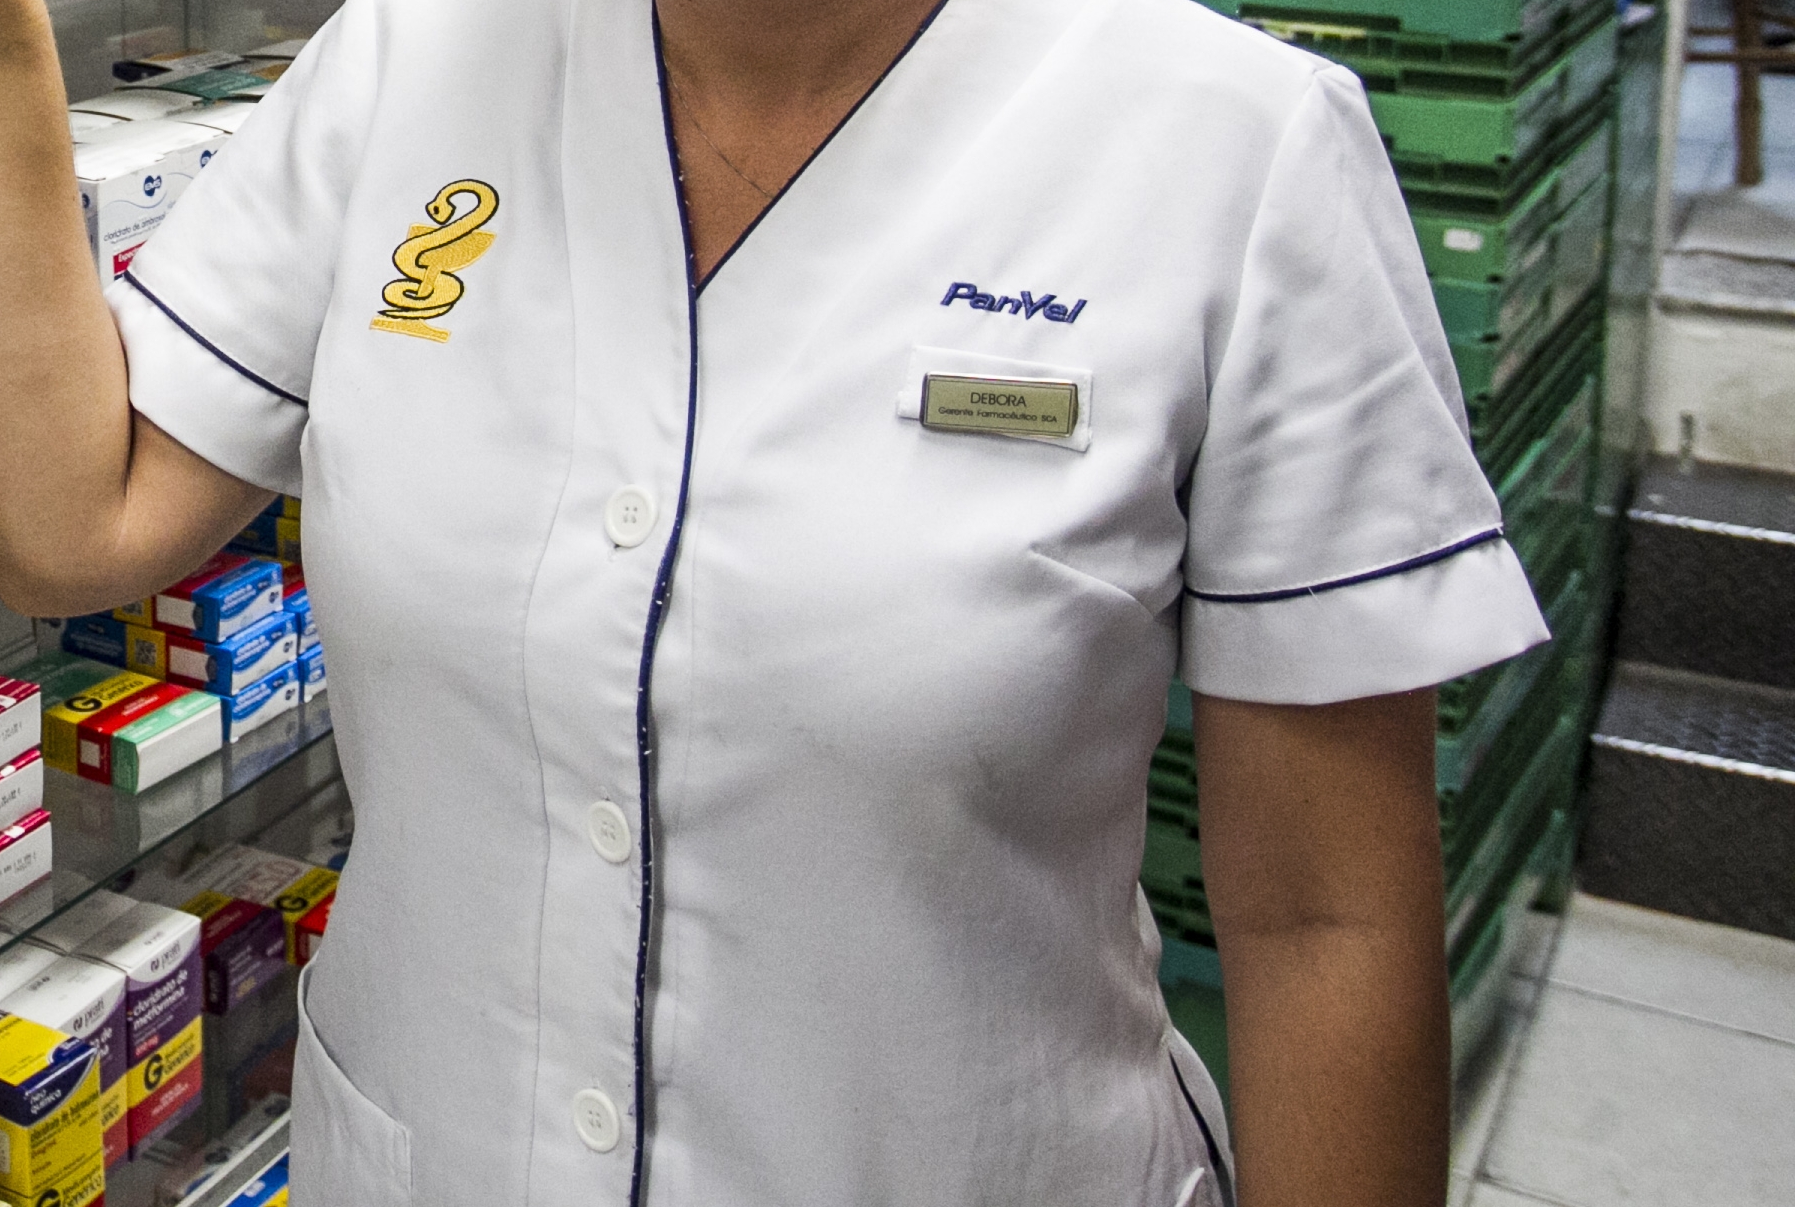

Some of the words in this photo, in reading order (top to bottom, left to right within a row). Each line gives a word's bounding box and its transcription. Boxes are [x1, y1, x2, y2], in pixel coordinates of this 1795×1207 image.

[940, 282, 1087, 323] PanVel
[970, 392, 1026, 407] DEBORA
[938, 406, 973, 417] Gerente
[977, 409, 1037, 421] Farmacêutico
[64, 696, 103, 712] G
[275, 894, 308, 913] G
[134, 976, 176, 1016] cloridrato
[144, 1054, 163, 1091] G
